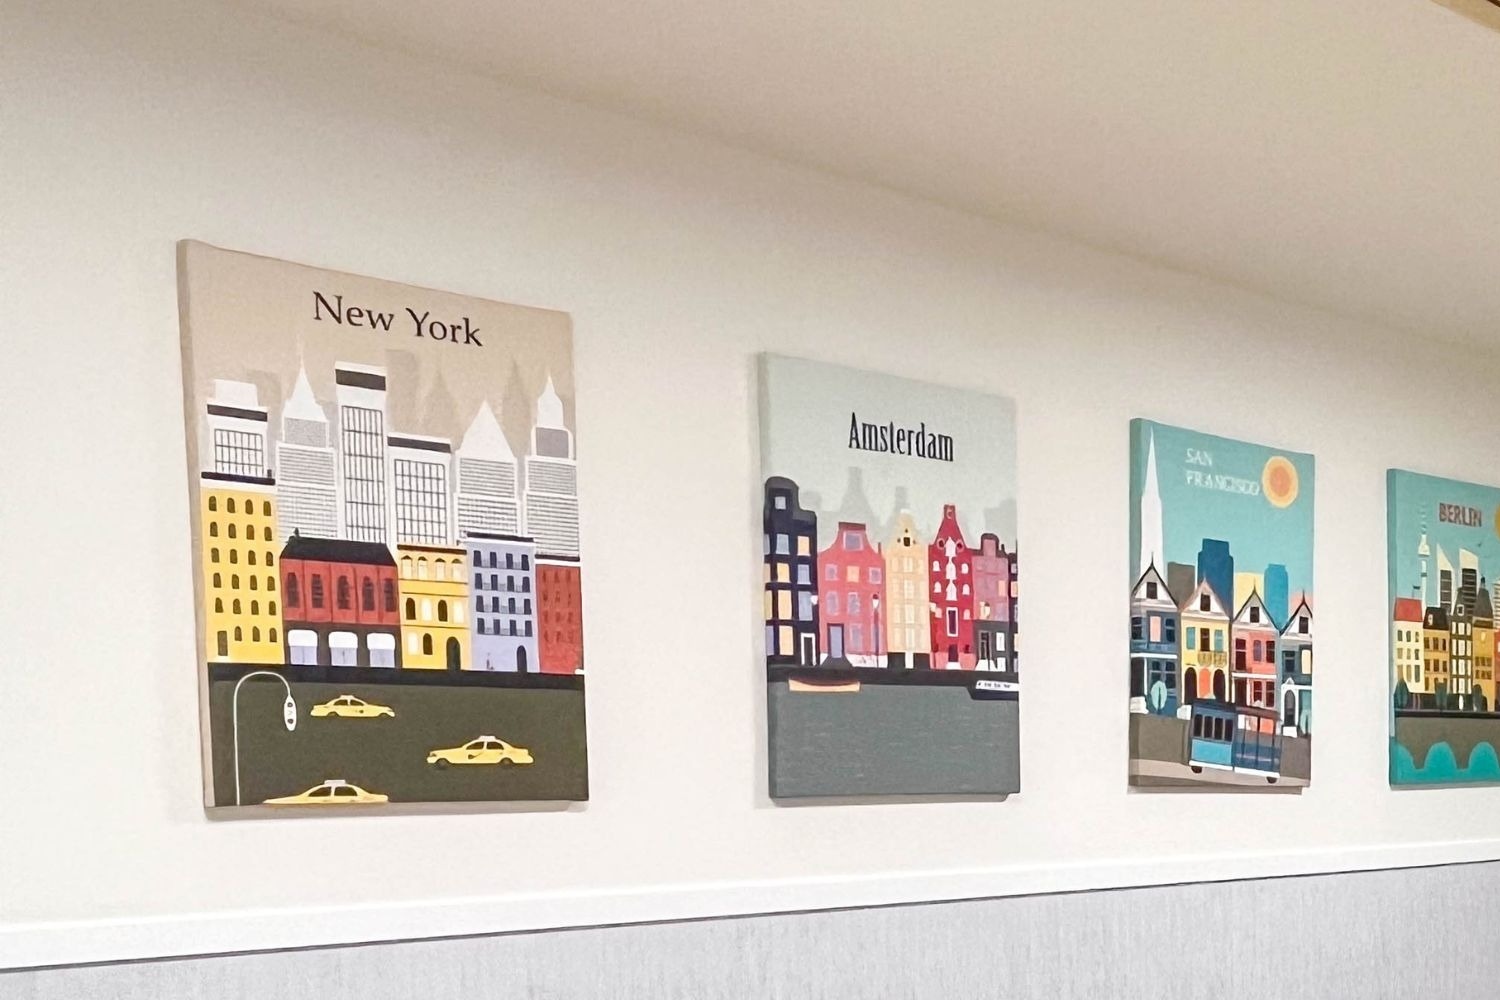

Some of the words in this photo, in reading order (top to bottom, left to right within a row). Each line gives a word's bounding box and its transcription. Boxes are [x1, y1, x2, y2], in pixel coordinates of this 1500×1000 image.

[313, 291, 394, 331] New
[406, 307, 483, 347] York
[848, 412, 954, 462] Amsterdam
[1186, 447, 1212, 465] SAN
[1439, 502, 1482, 528] BERLIN
